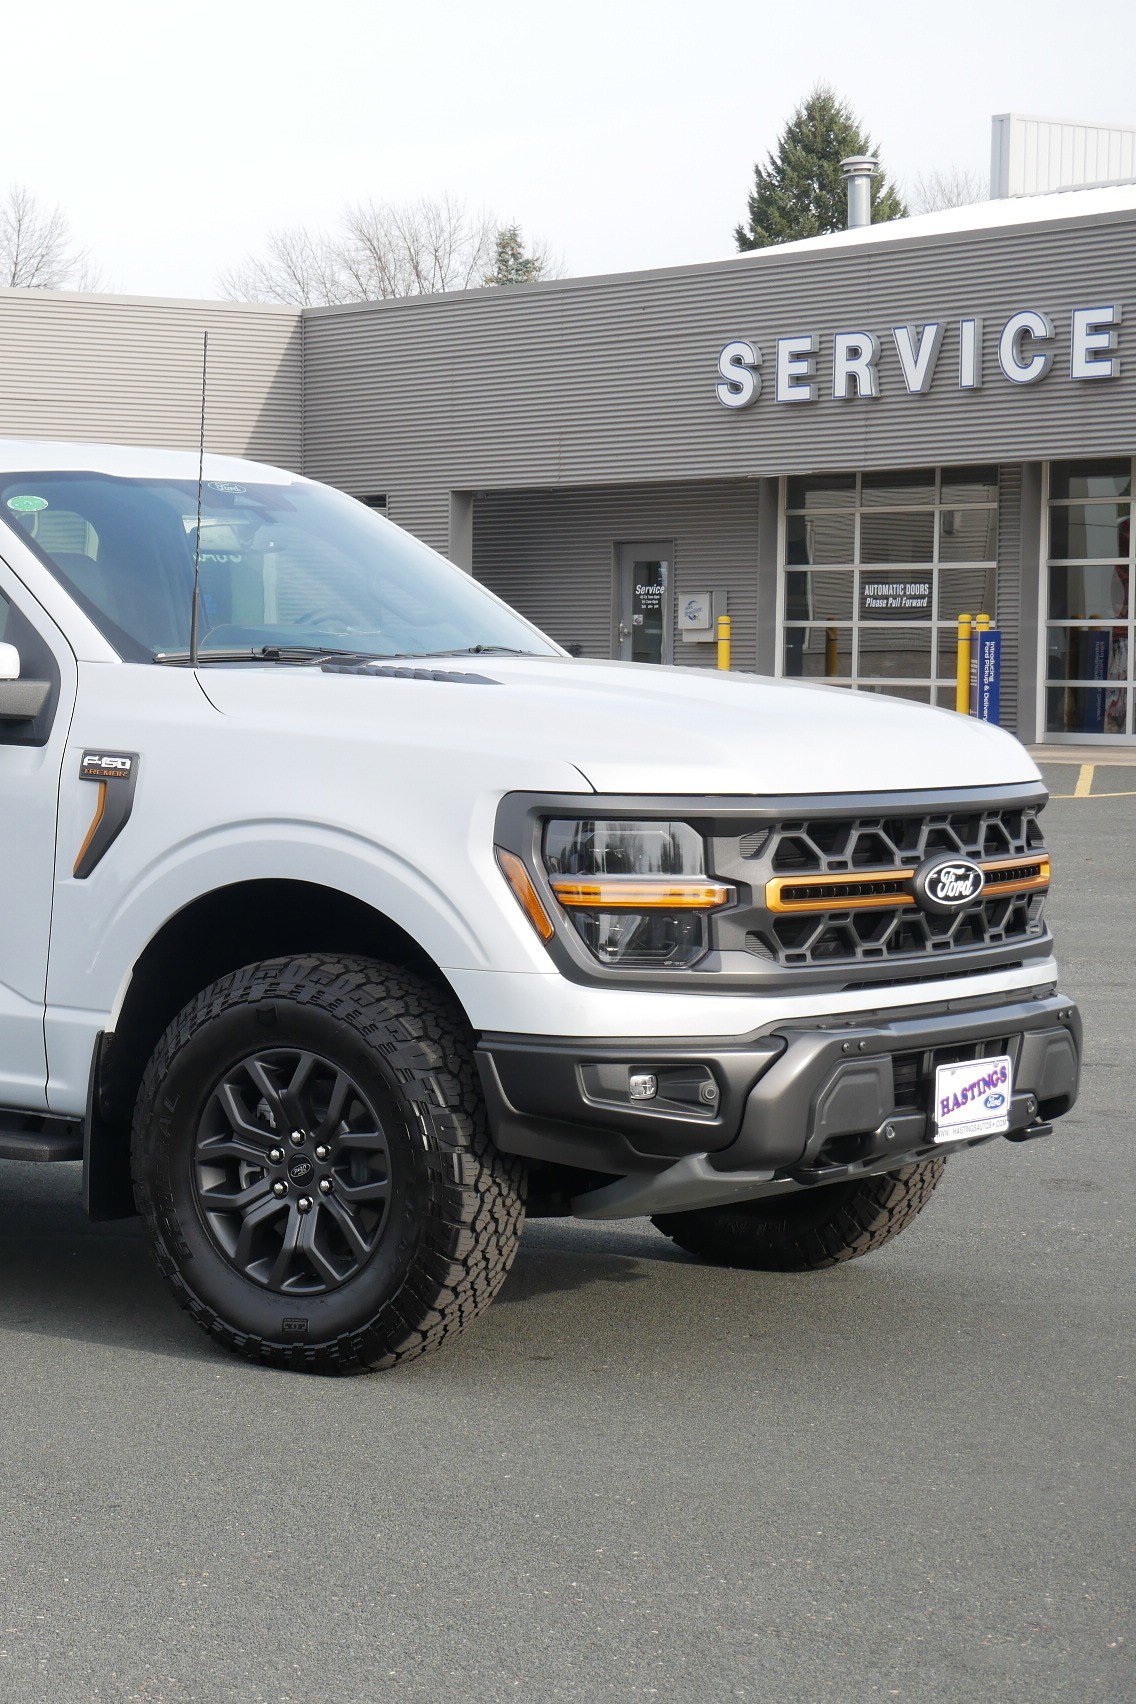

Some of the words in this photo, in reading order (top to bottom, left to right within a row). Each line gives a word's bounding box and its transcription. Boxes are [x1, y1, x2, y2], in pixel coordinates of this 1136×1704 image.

[715, 304, 1123, 409] SERVICE
[635, 584, 665, 595] Service
[865, 584, 904, 596] AUTOMATIC
[906, 583, 929, 595] DOORS
[866, 597, 887, 608] Please
[888, 597, 901, 607] Pull
[902, 596, 928, 607] Forward
[82, 755, 132, 770] F-150
[84, 768, 128, 777] TREMOR
[936, 867, 974, 898] Ford
[940, 1065, 1008, 1118] HASTINGS
